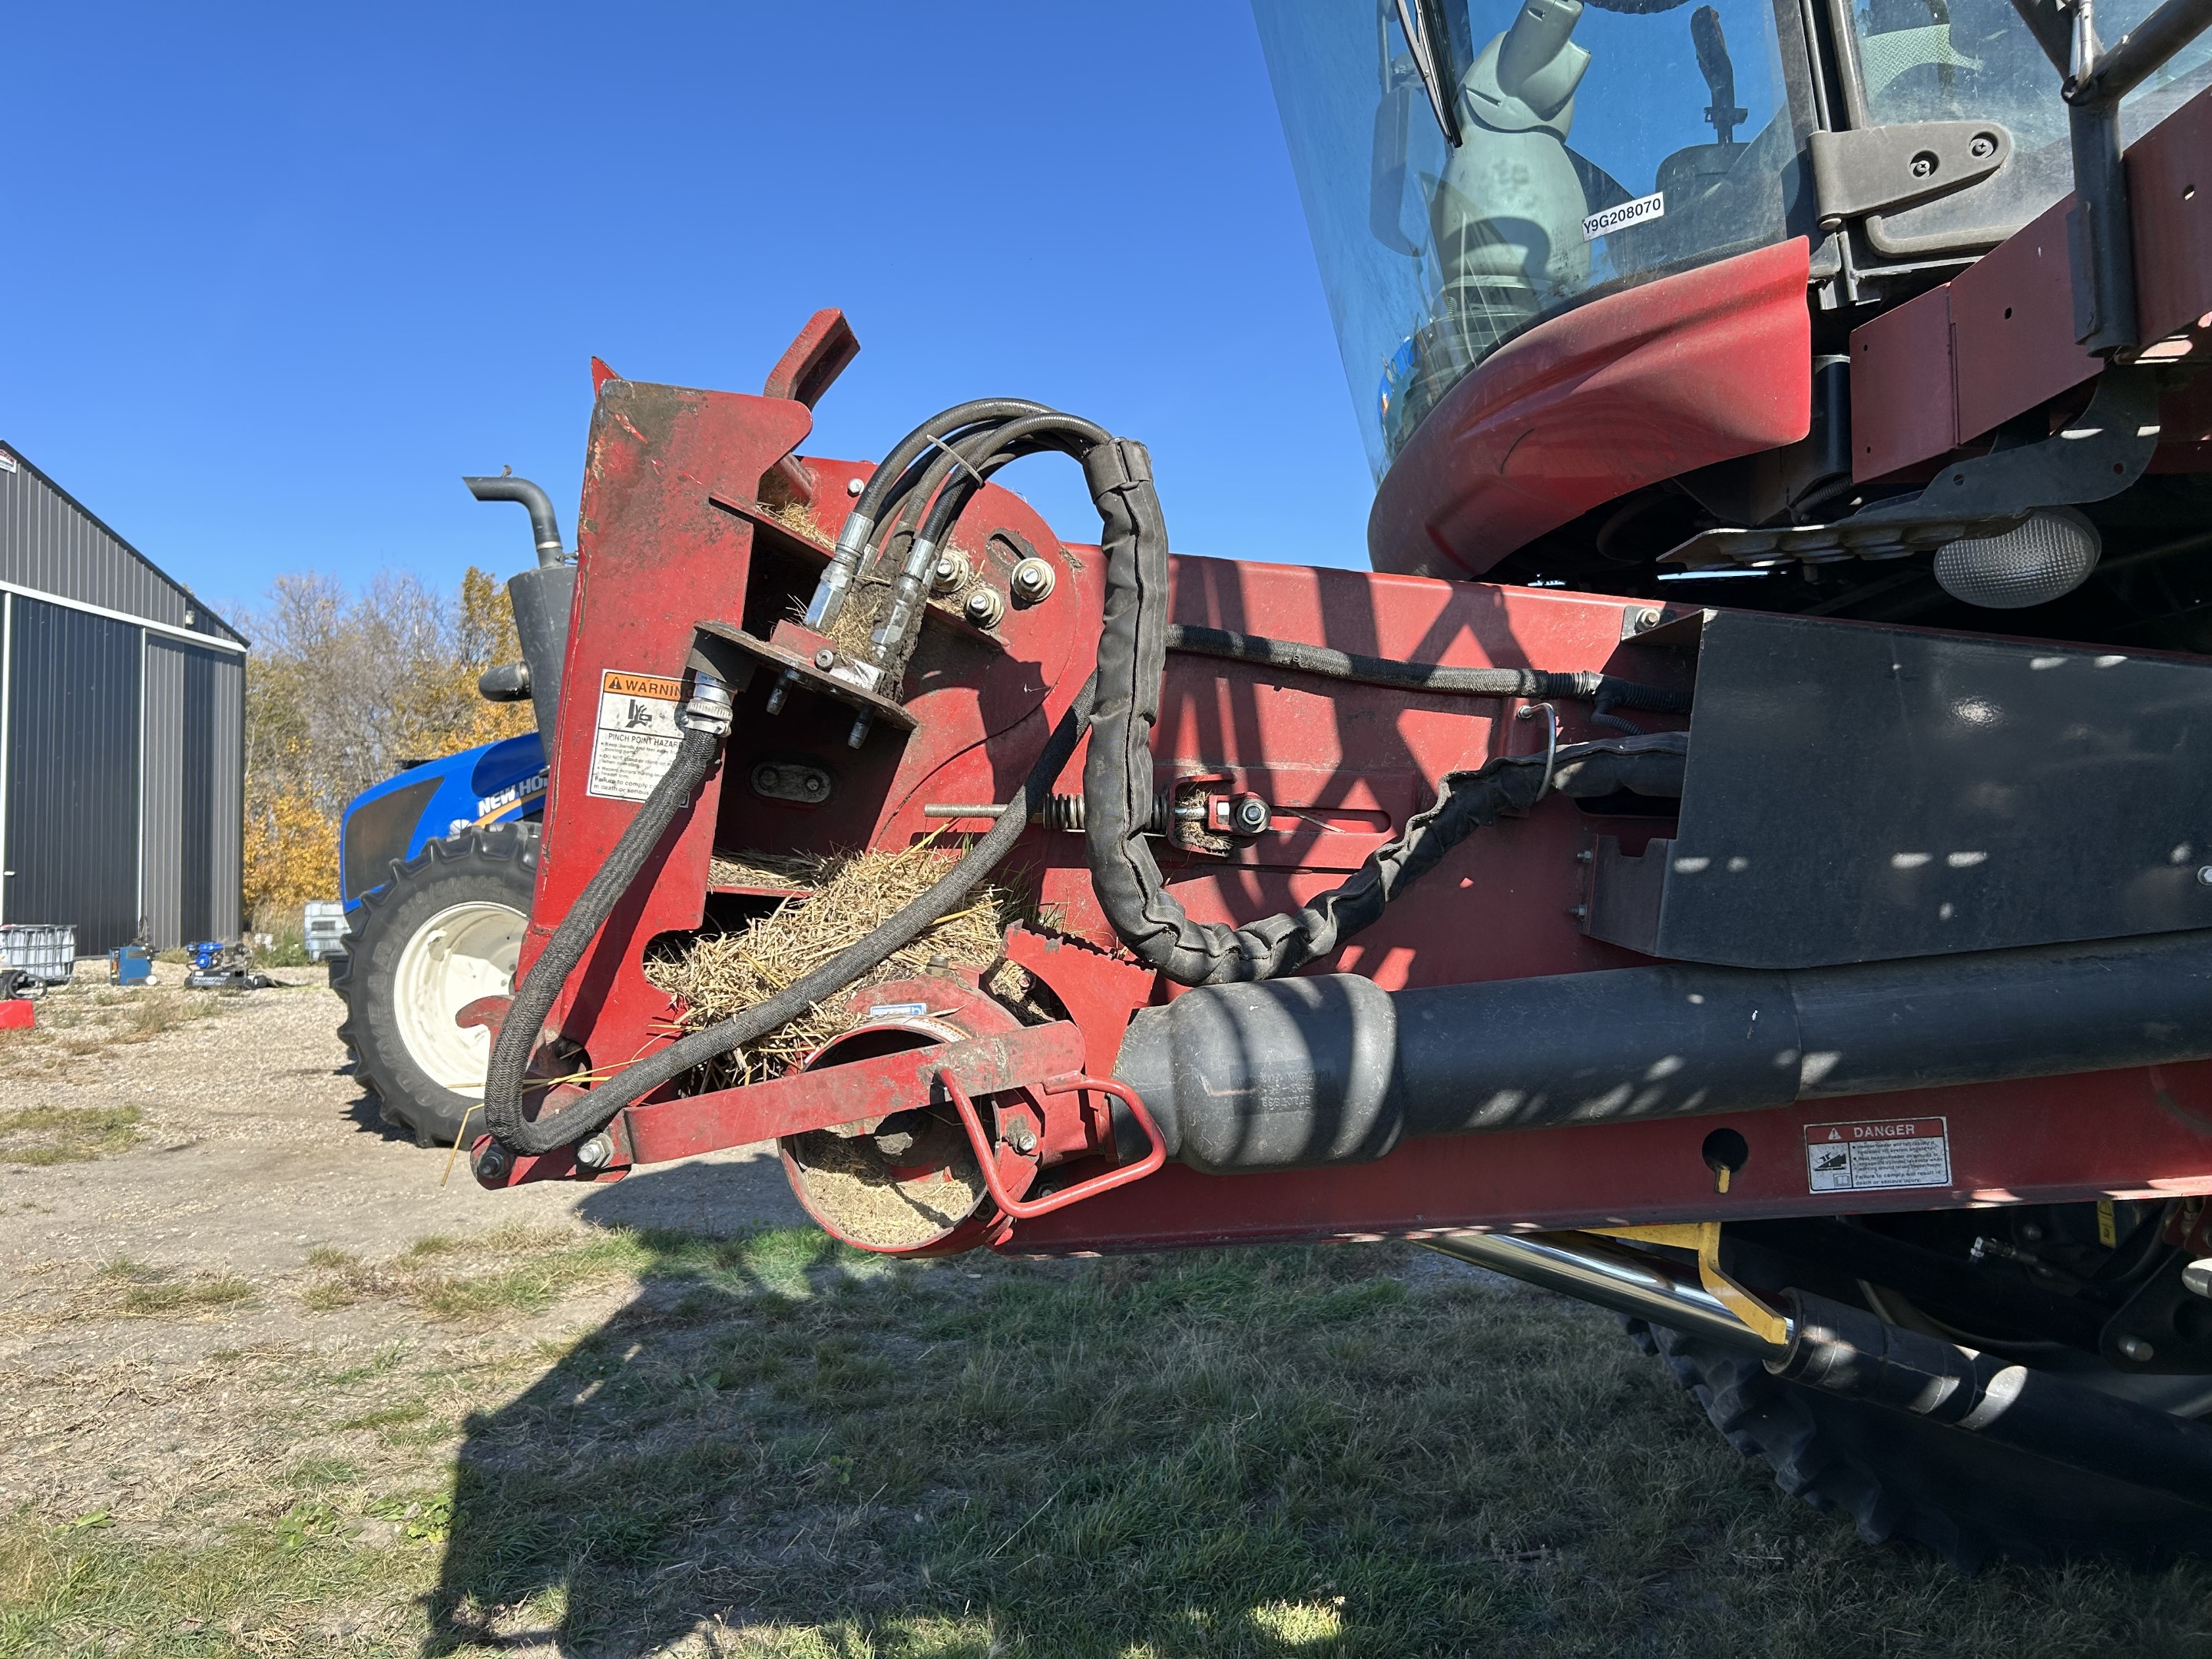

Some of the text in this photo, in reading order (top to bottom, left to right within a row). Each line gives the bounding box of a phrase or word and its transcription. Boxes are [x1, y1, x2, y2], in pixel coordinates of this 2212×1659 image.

[1583, 197, 1661, 233] Y9G208070
[608, 733, 630, 742] PINCH
[631, 735, 652, 744] POINT
[594, 776, 616, 784] Failure
[625, 780, 648, 789] comply
[478, 785, 516, 817] NEW
[1853, 1124, 1916, 1138] DANGER
